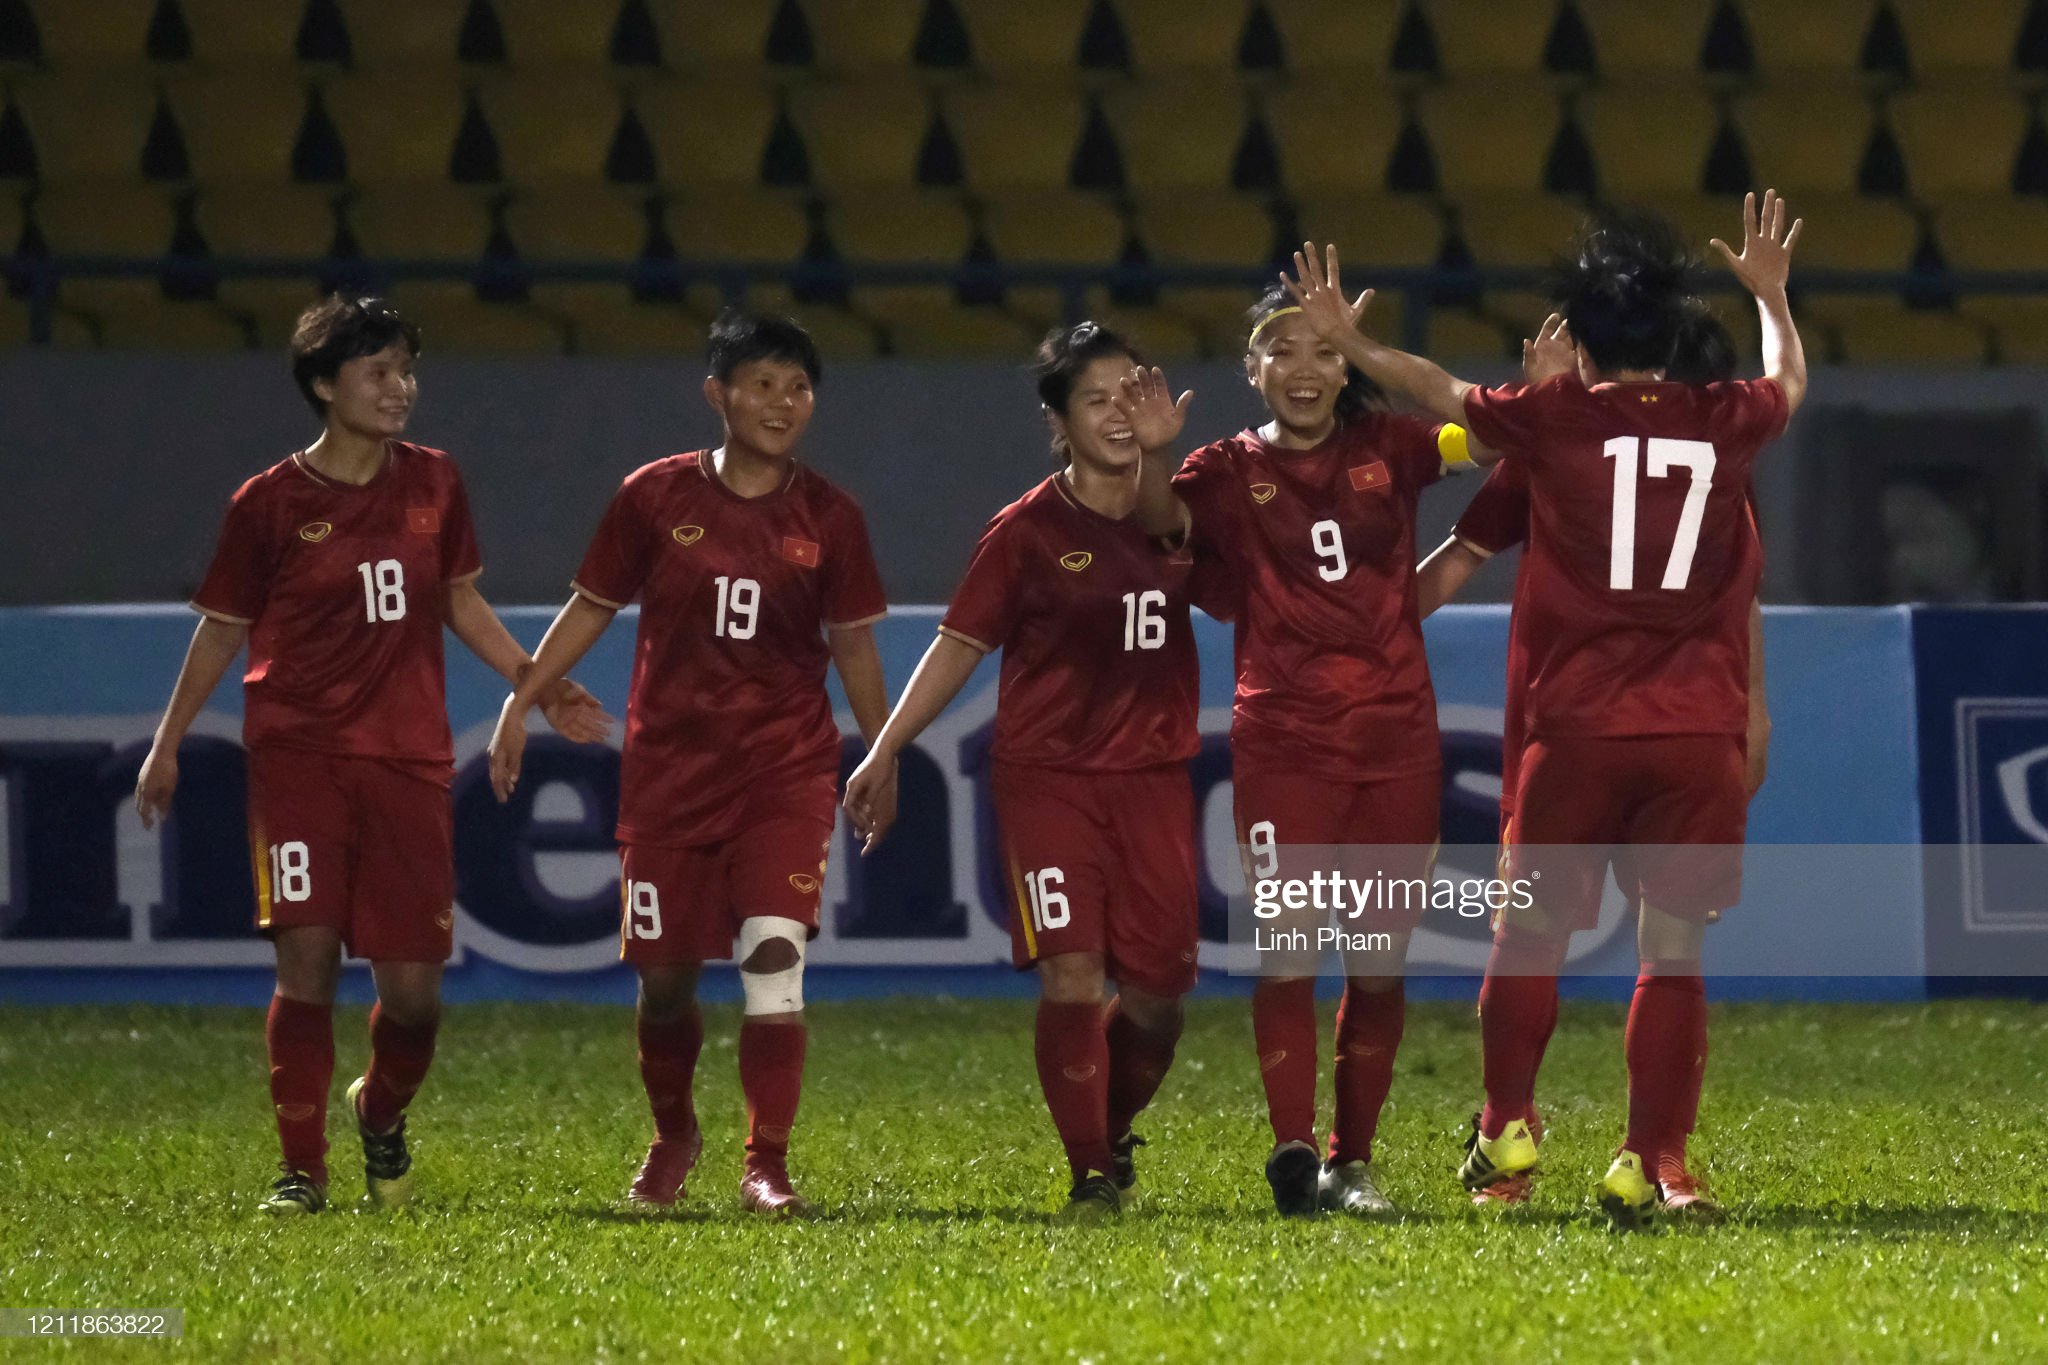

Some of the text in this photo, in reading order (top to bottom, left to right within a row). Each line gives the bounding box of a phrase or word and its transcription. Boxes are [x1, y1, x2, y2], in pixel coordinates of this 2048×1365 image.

[1603, 435, 1717, 590] 17
[1310, 519, 1348, 583] 9
[357, 558, 407, 623] 18
[714, 576, 761, 640] 19
[1122, 589, 1166, 651] 16
[270, 841, 312, 903] 18
[1249, 820, 1279, 880] 9
[625, 878, 663, 940] 19
[1024, 866, 1071, 932] 16
